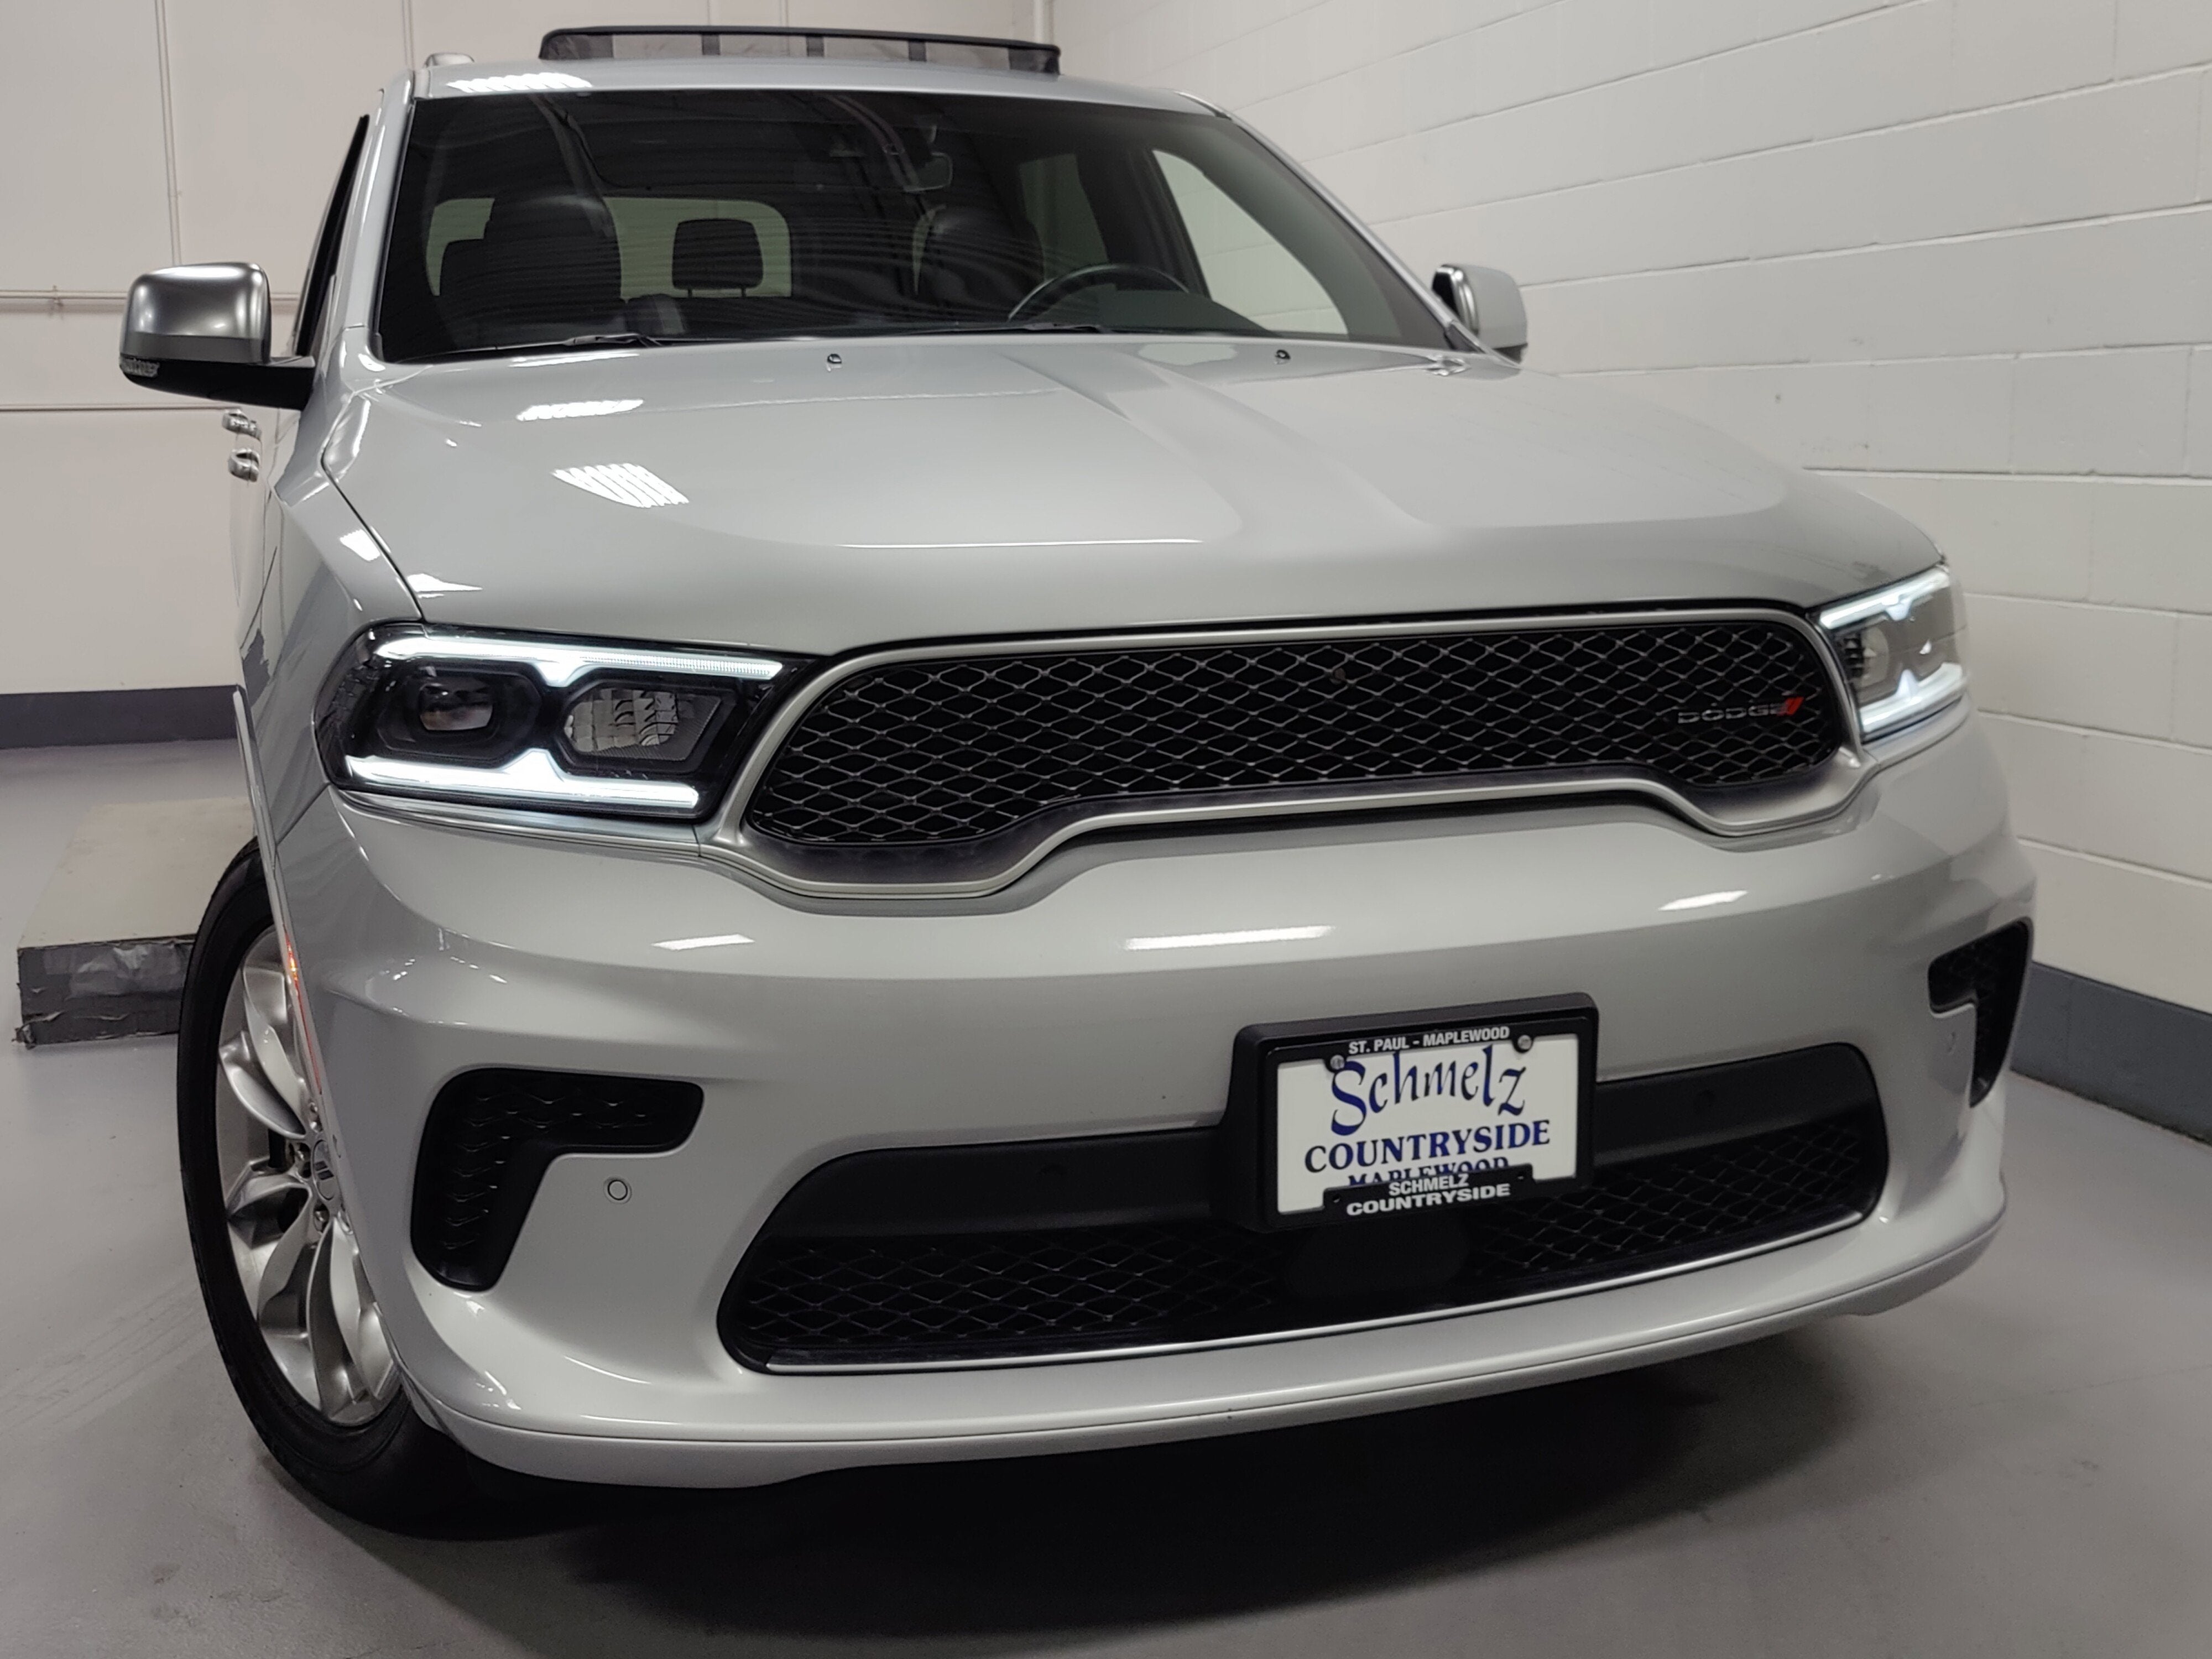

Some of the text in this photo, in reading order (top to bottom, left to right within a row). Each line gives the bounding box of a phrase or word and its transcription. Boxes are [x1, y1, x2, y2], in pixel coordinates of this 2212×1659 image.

[1678, 703, 1787, 724] DODGE
[1348, 1040, 1370, 1055] ST.
[1374, 1036, 1410, 1051] PAUL
[1423, 1026, 1510, 1047] MAPLEWOOD
[1331, 1045, 1527, 1136] Schmelz
[1305, 1119, 1551, 1173] COUNTRYSIDE
[1346, 1183, 1511, 1216] COUNTRYSIDE
[1389, 1173, 1469, 1196] SCHMELZ
